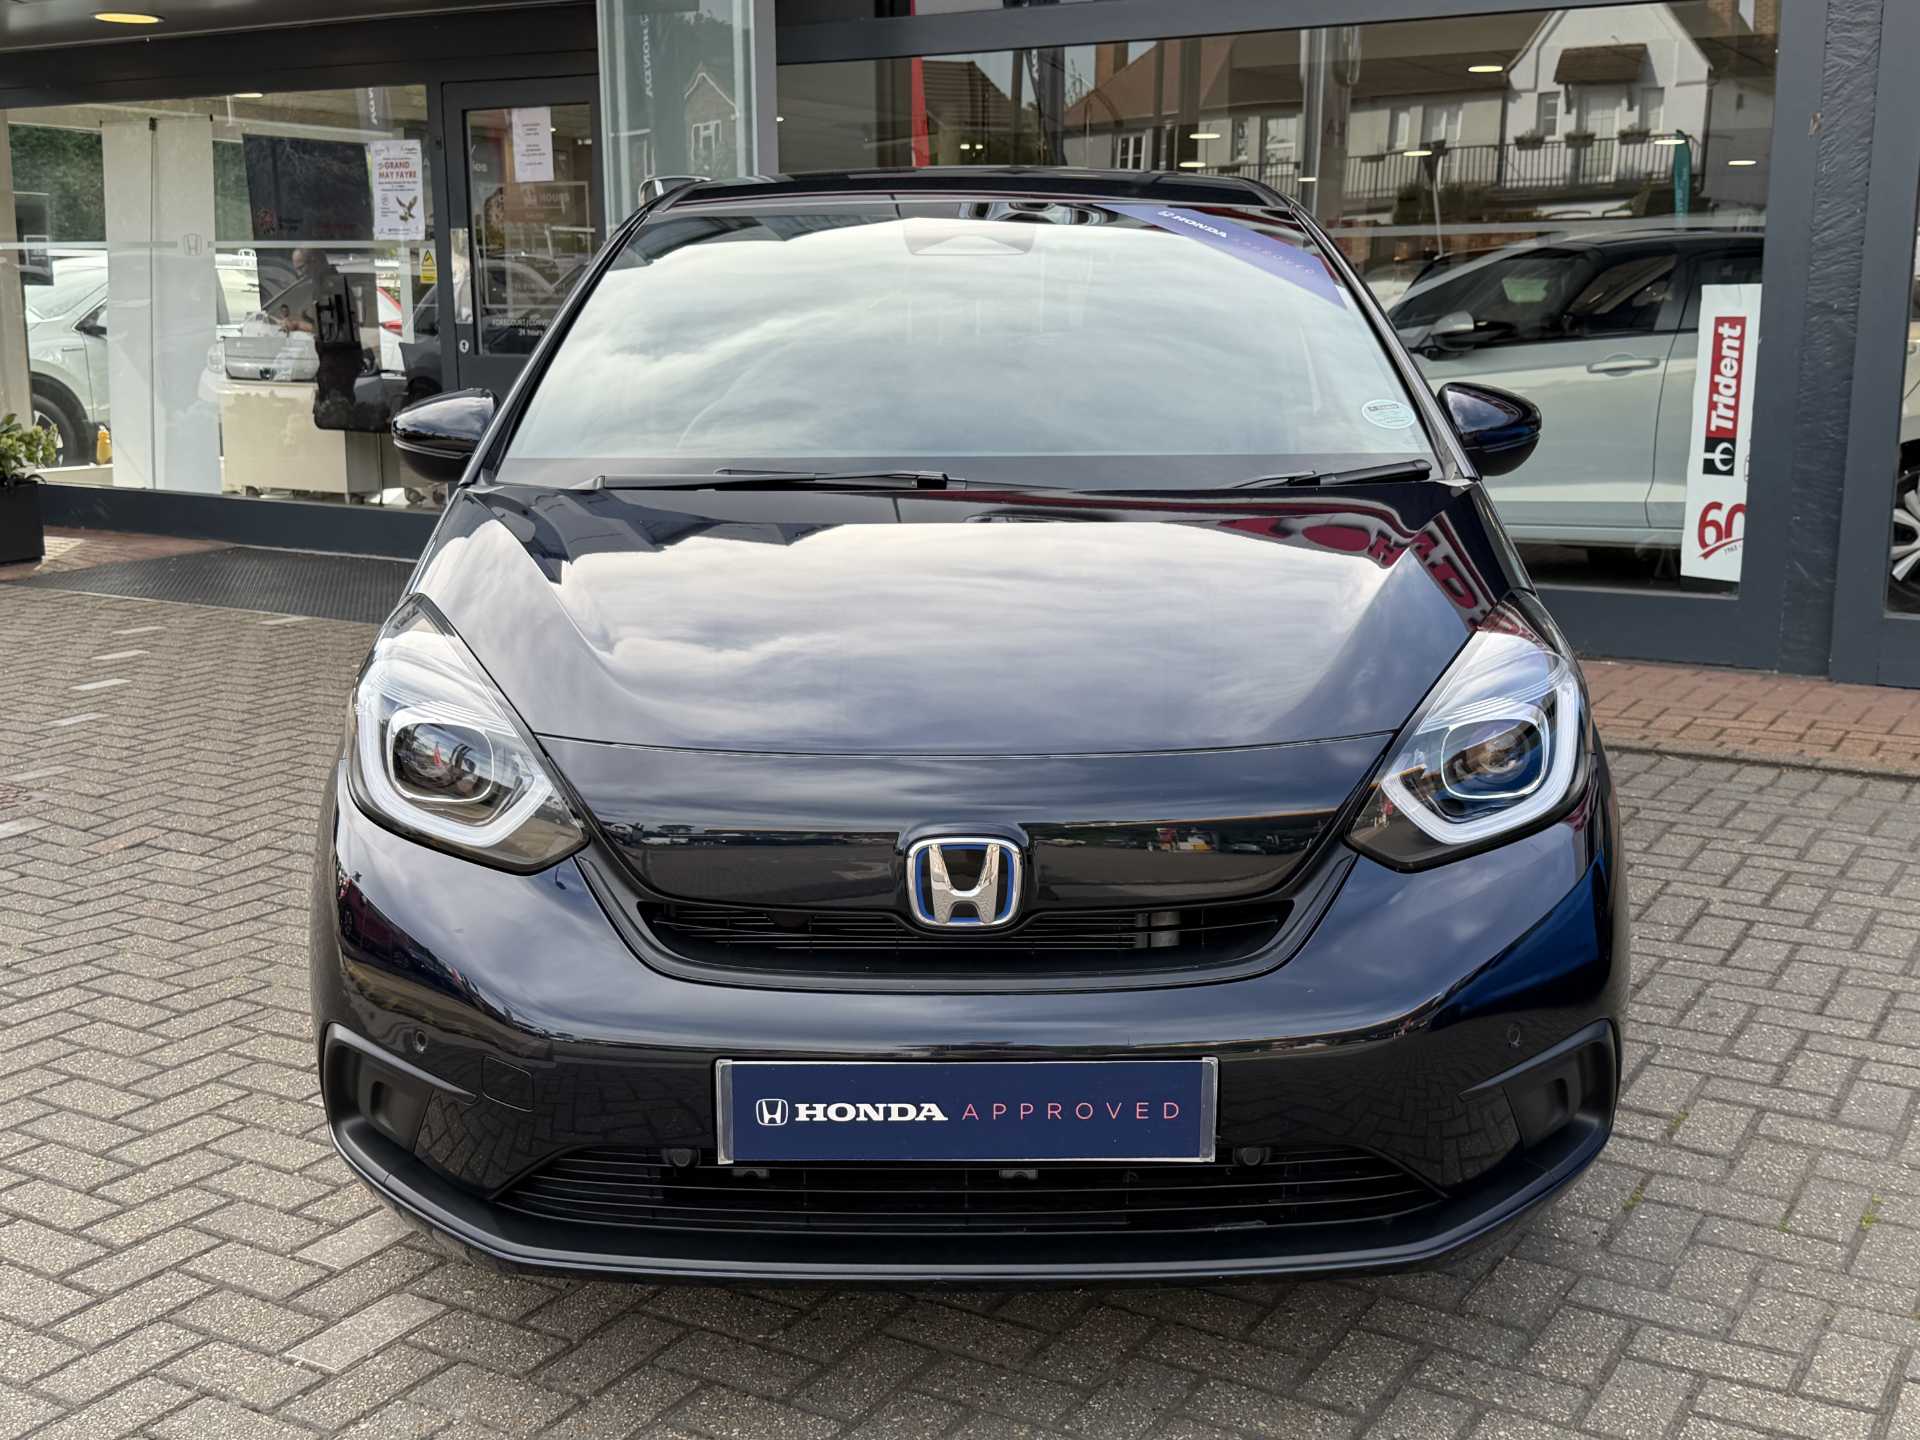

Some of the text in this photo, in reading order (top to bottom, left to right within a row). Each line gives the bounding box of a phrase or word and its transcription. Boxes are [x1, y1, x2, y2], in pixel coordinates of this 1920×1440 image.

[384, 160, 410, 169] GRAND
[1173, 215, 1228, 238] HONDA
[1710, 322, 1742, 432] Trident
[795, 1102, 949, 1122] HONDA
[962, 1101, 1181, 1121] APPROVED
